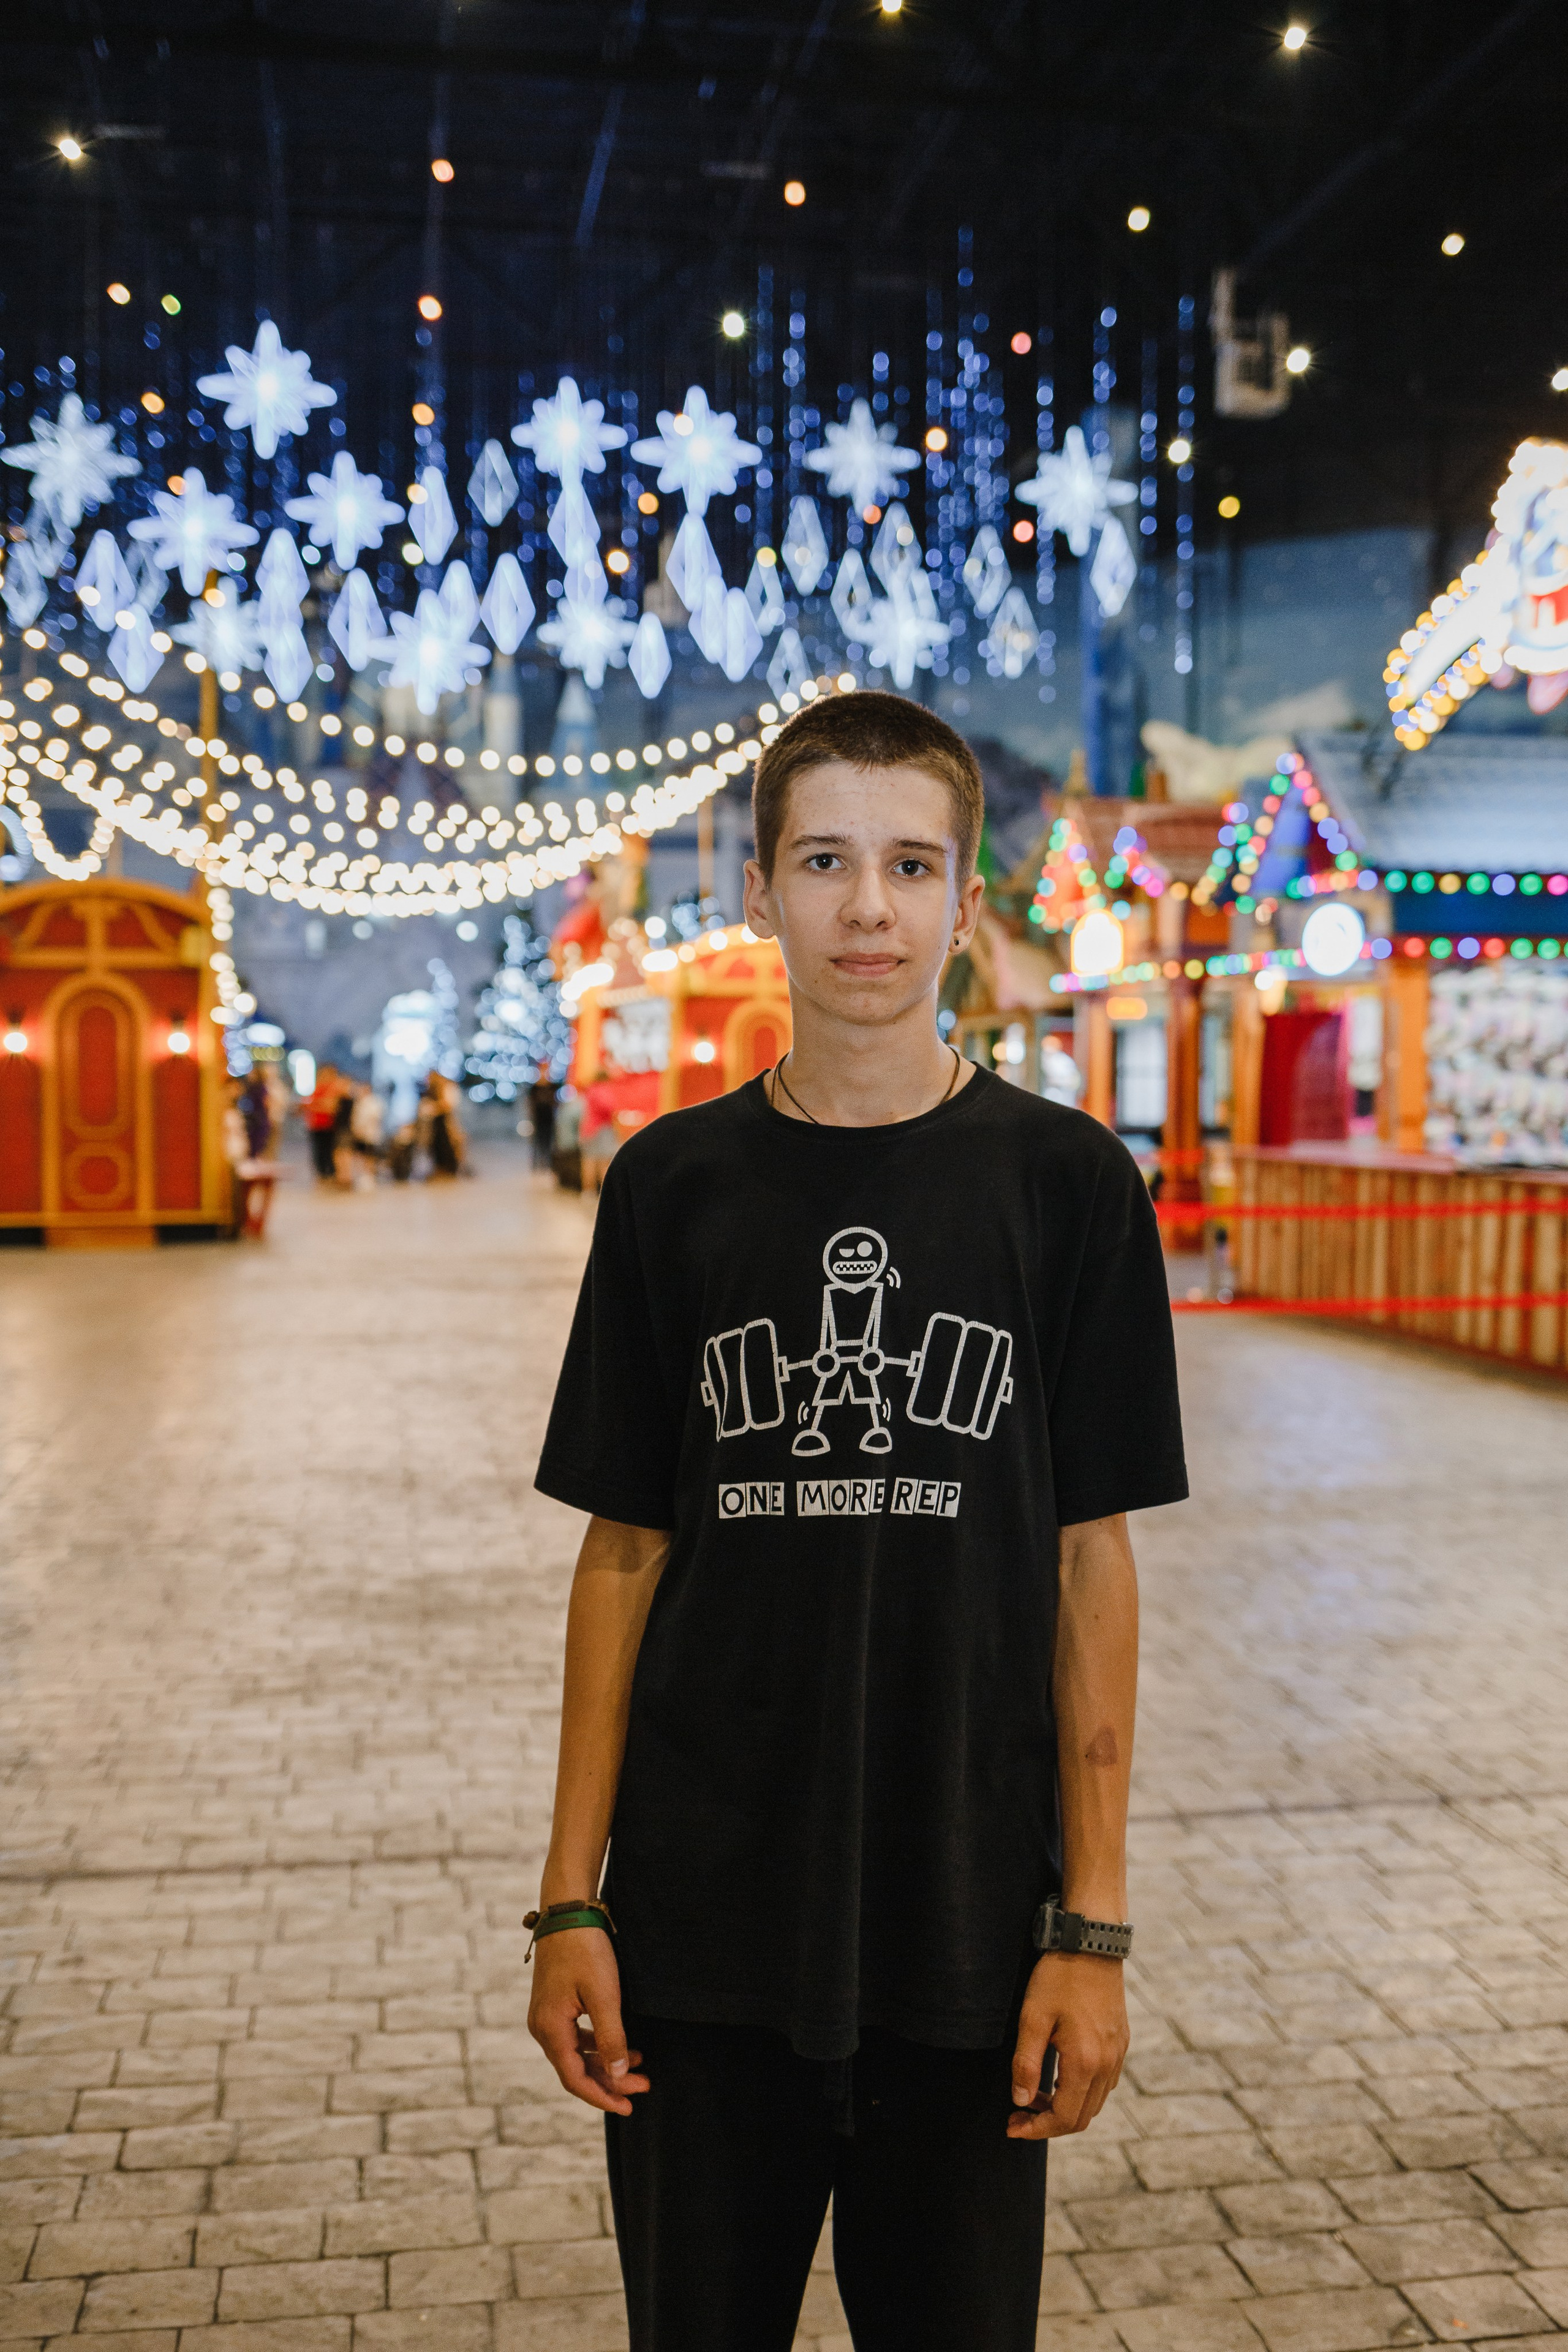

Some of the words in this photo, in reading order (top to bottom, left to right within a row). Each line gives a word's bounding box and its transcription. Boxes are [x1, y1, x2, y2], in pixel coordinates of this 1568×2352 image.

[720, 1483, 783, 1516] ONE
[799, 1480, 885, 1514] MORE
[892, 1480, 960, 1515] REP
